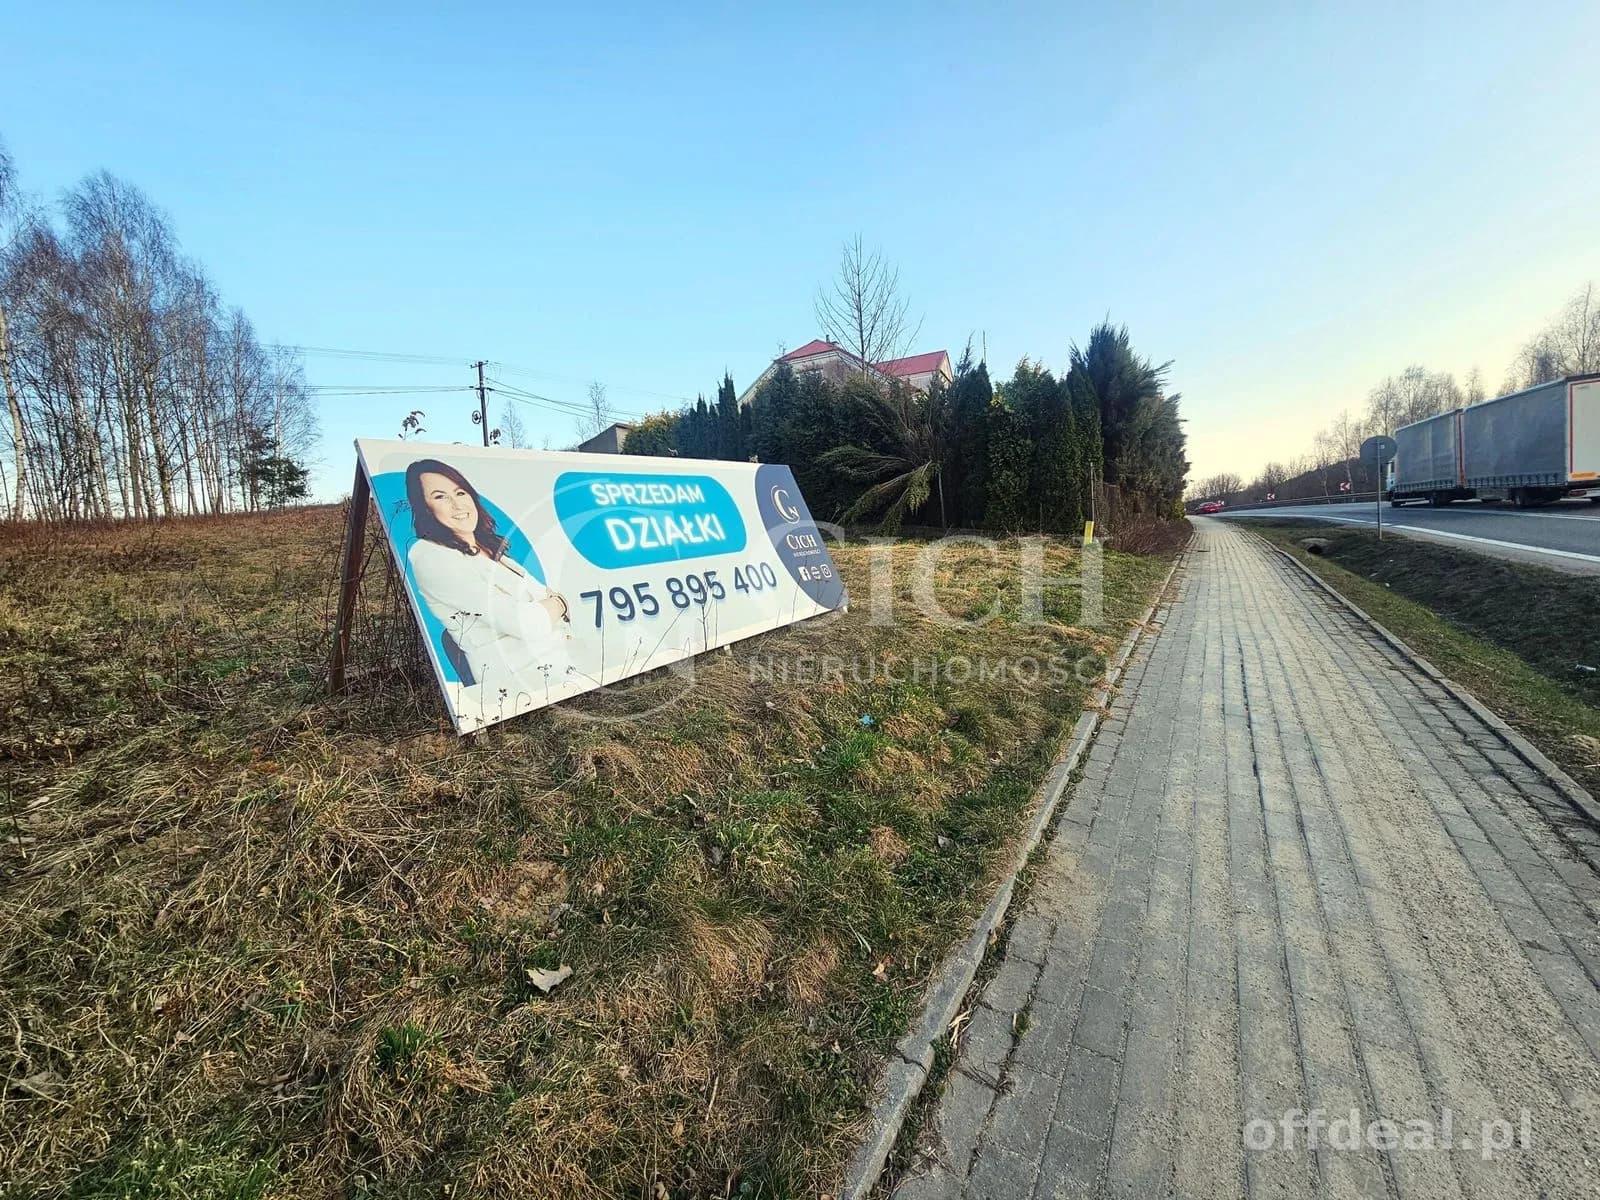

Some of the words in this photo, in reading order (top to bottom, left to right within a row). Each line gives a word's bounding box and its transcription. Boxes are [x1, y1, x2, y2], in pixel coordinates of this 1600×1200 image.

[591, 483, 706, 506] SPRZEDAM
[605, 514, 726, 551] DZIAŁKI
[786, 533, 818, 550] CICH
[579, 582, 660, 629] 795
[665, 570, 726, 609] 895
[734, 561, 777, 594] 400
